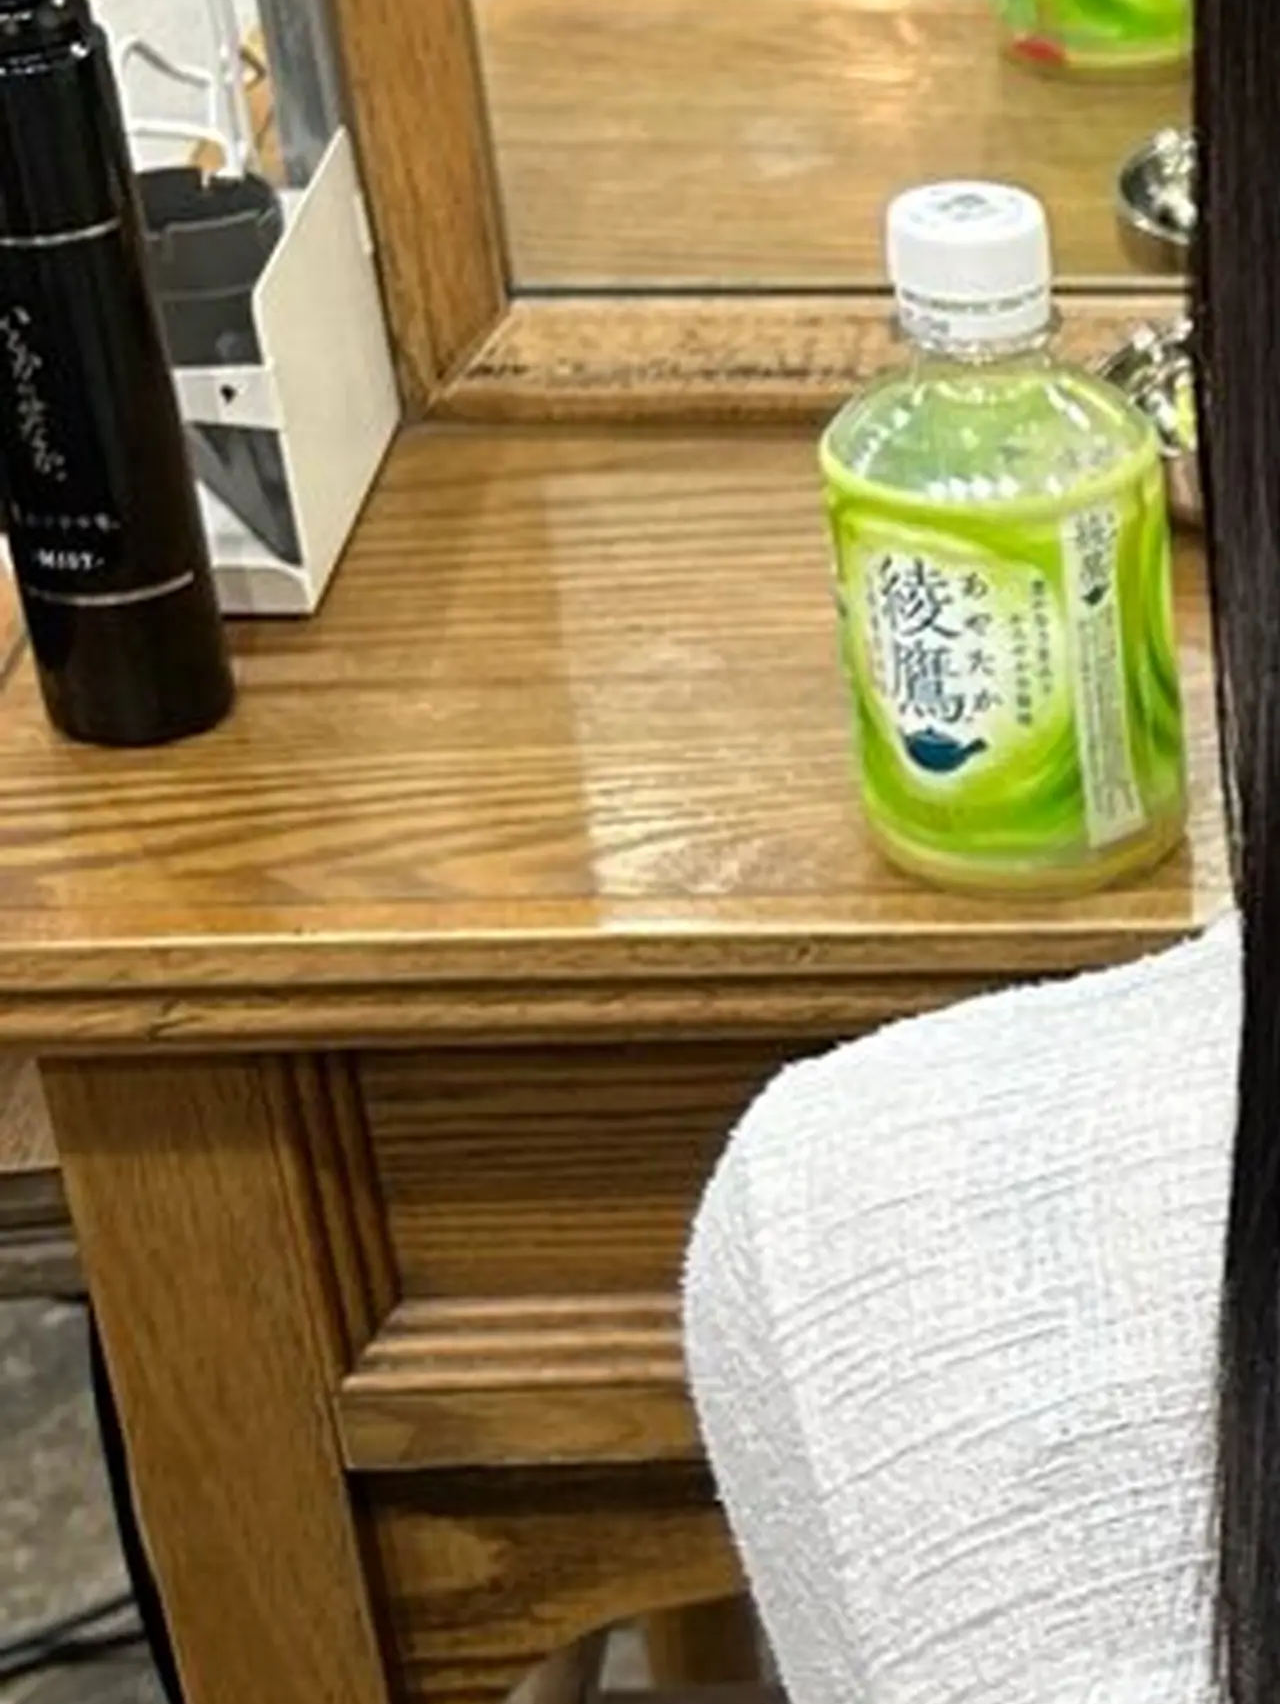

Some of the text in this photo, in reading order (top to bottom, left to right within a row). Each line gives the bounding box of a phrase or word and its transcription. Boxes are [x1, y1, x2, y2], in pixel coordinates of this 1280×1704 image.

[880, 556, 964, 725] 綾鷹
[963, 571, 1006, 714] あやたか
